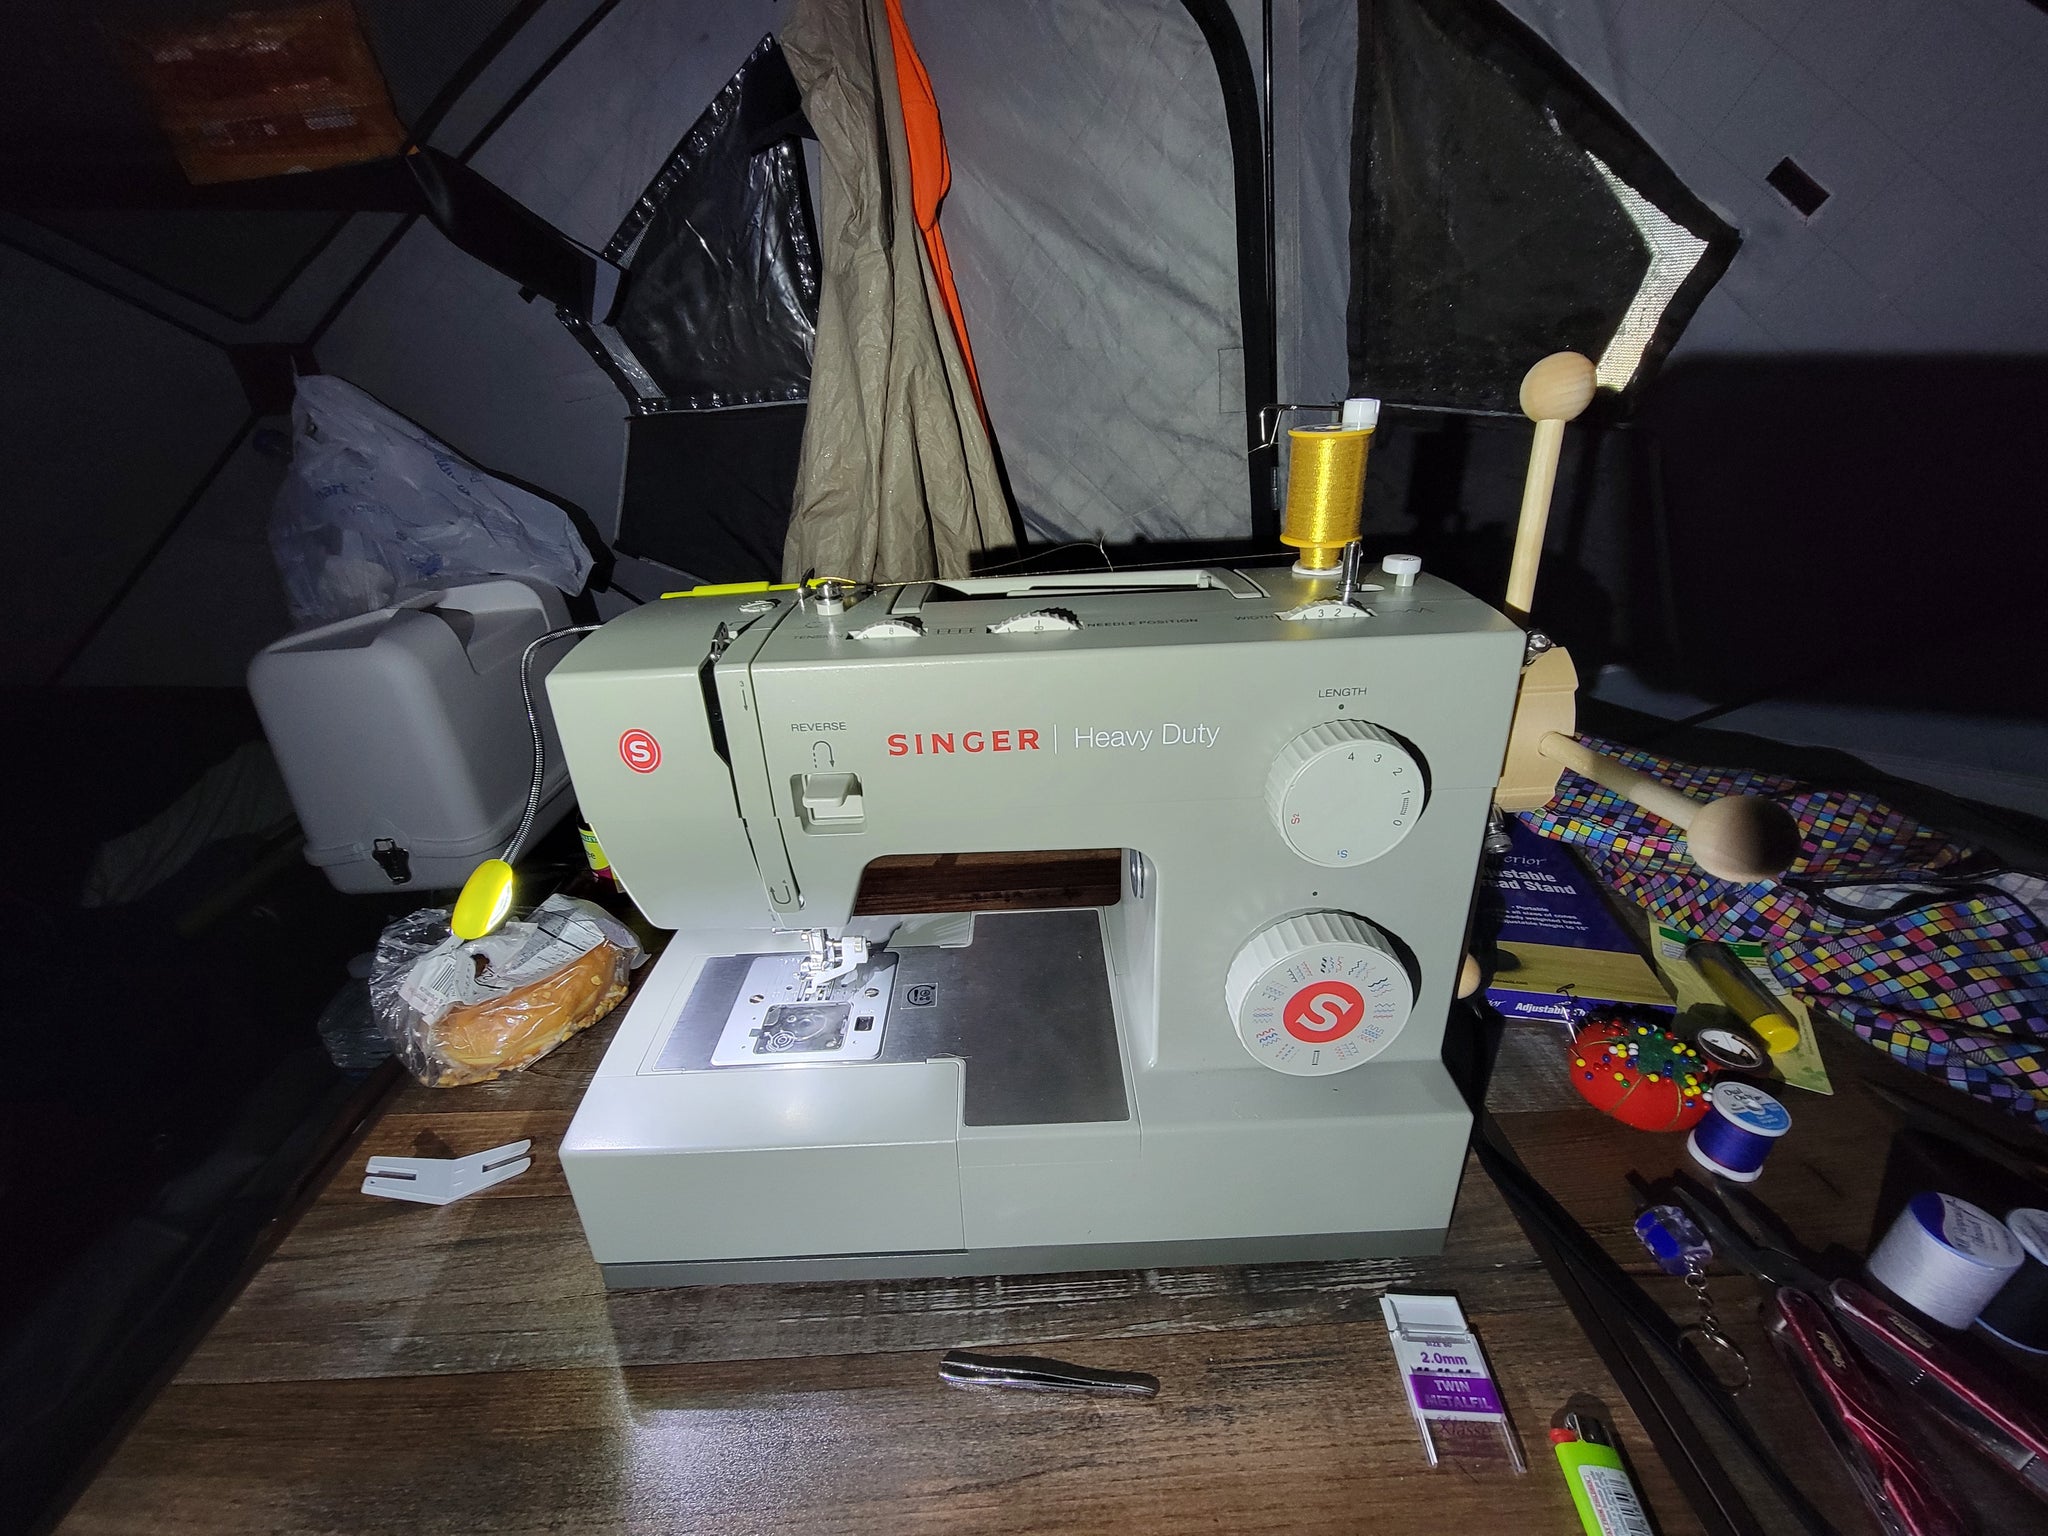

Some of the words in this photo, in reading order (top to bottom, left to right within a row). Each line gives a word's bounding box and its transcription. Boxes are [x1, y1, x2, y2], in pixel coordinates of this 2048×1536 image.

[1318, 608, 1325, 618] 3
[1334, 607, 1342, 617] 2
[1318, 687, 1368, 699] LENGTH
[791, 721, 847, 733] REVERSE
[887, 729, 1041, 757] SINGER
[1074, 727, 1153, 751] Heavy
[1162, 723, 1221, 749] Duty
[628, 740, 652, 763] S
[1347, 752, 1355, 762] 4
[1373, 753, 1383, 764] 3
[1392, 767, 1403, 777] 2
[1523, 880, 1577, 895] Stand
[1515, 1002, 1571, 1015] Adjustable
[1420, 1351, 1468, 1365] 2.0mm
[1433, 1379, 1471, 1393] TWIN
[1424, 1394, 1493, 1410] METALFIL
